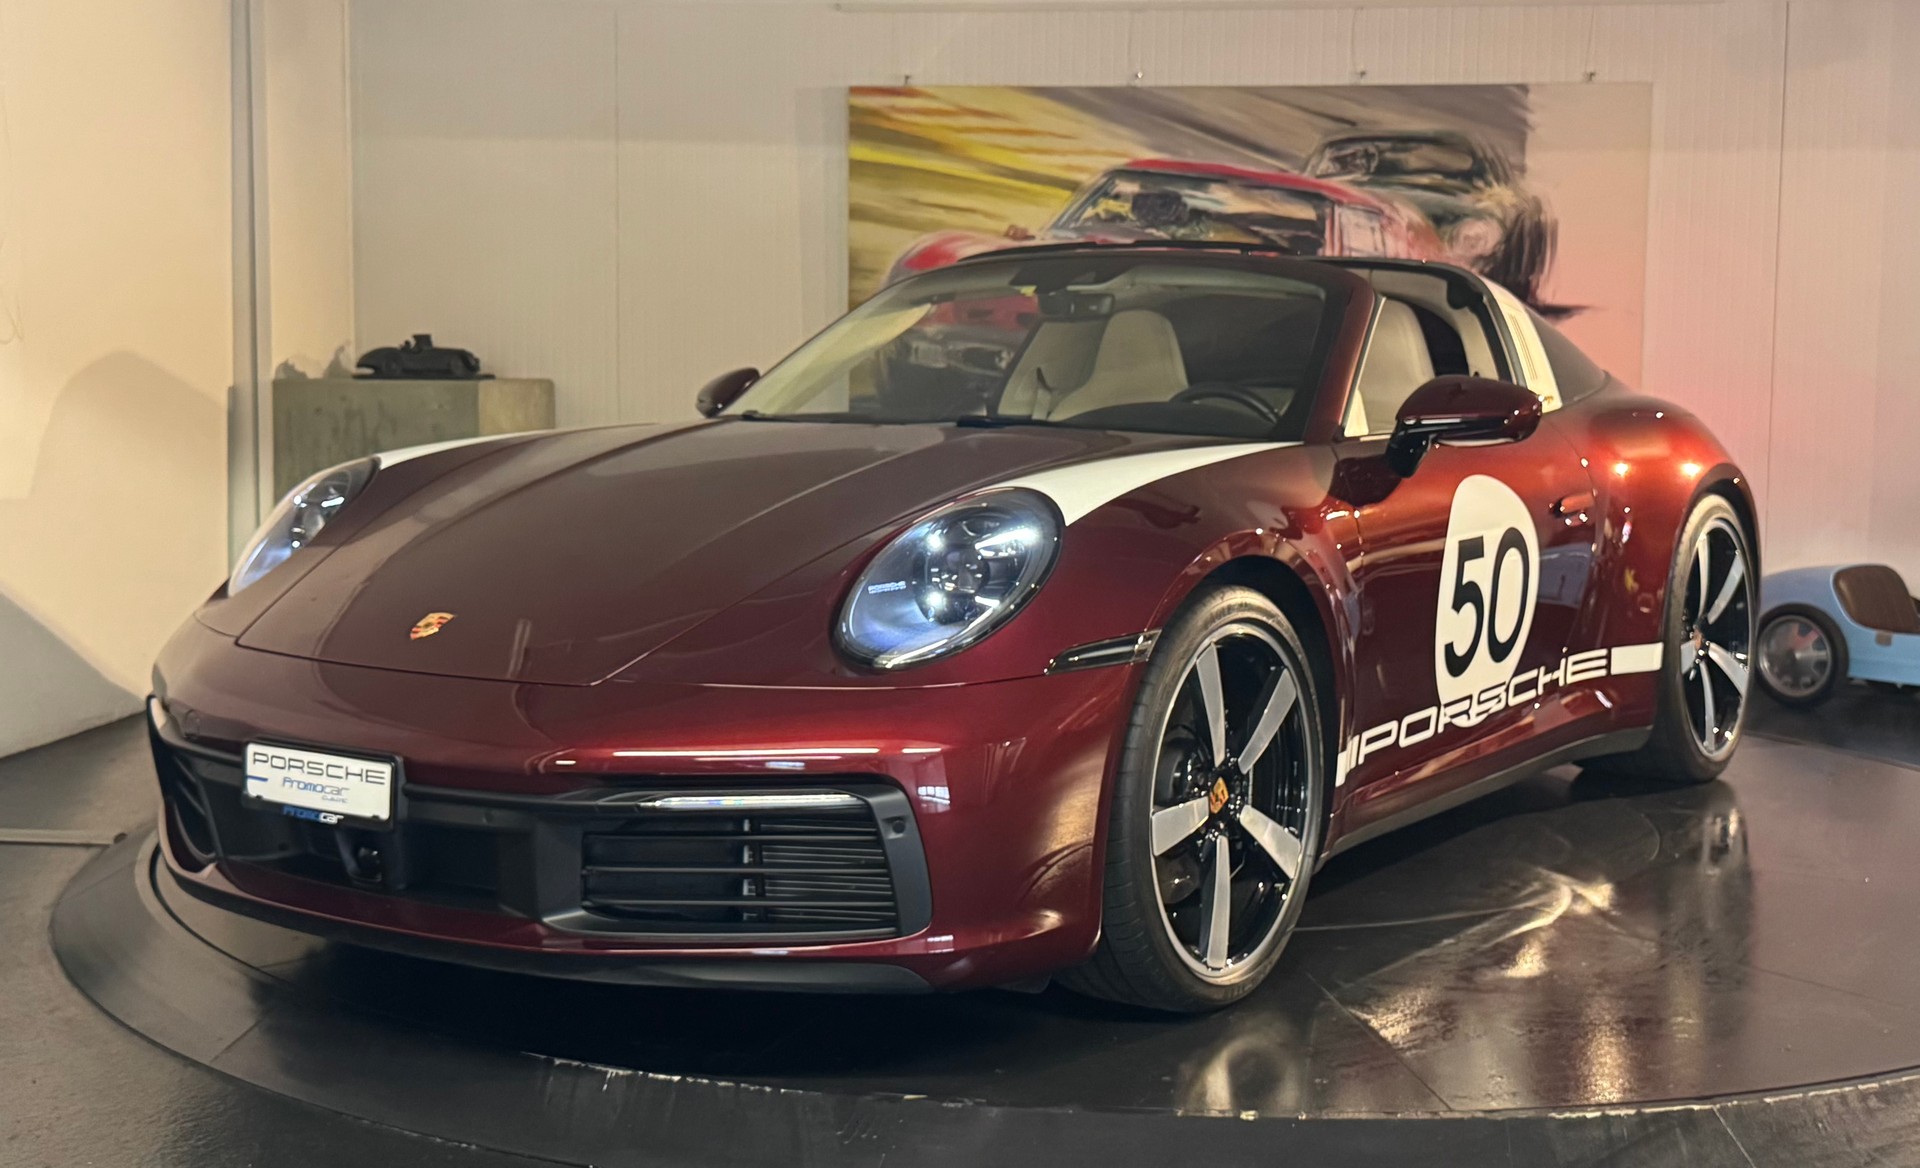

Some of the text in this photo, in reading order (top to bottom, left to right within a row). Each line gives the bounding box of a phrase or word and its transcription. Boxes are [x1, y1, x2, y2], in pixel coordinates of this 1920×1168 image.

[1444, 526, 1530, 678] 50
[1358, 648, 1608, 766] PORSCHE
[253, 751, 386, 786] PORSCHE
[283, 776, 350, 797] Promocar
